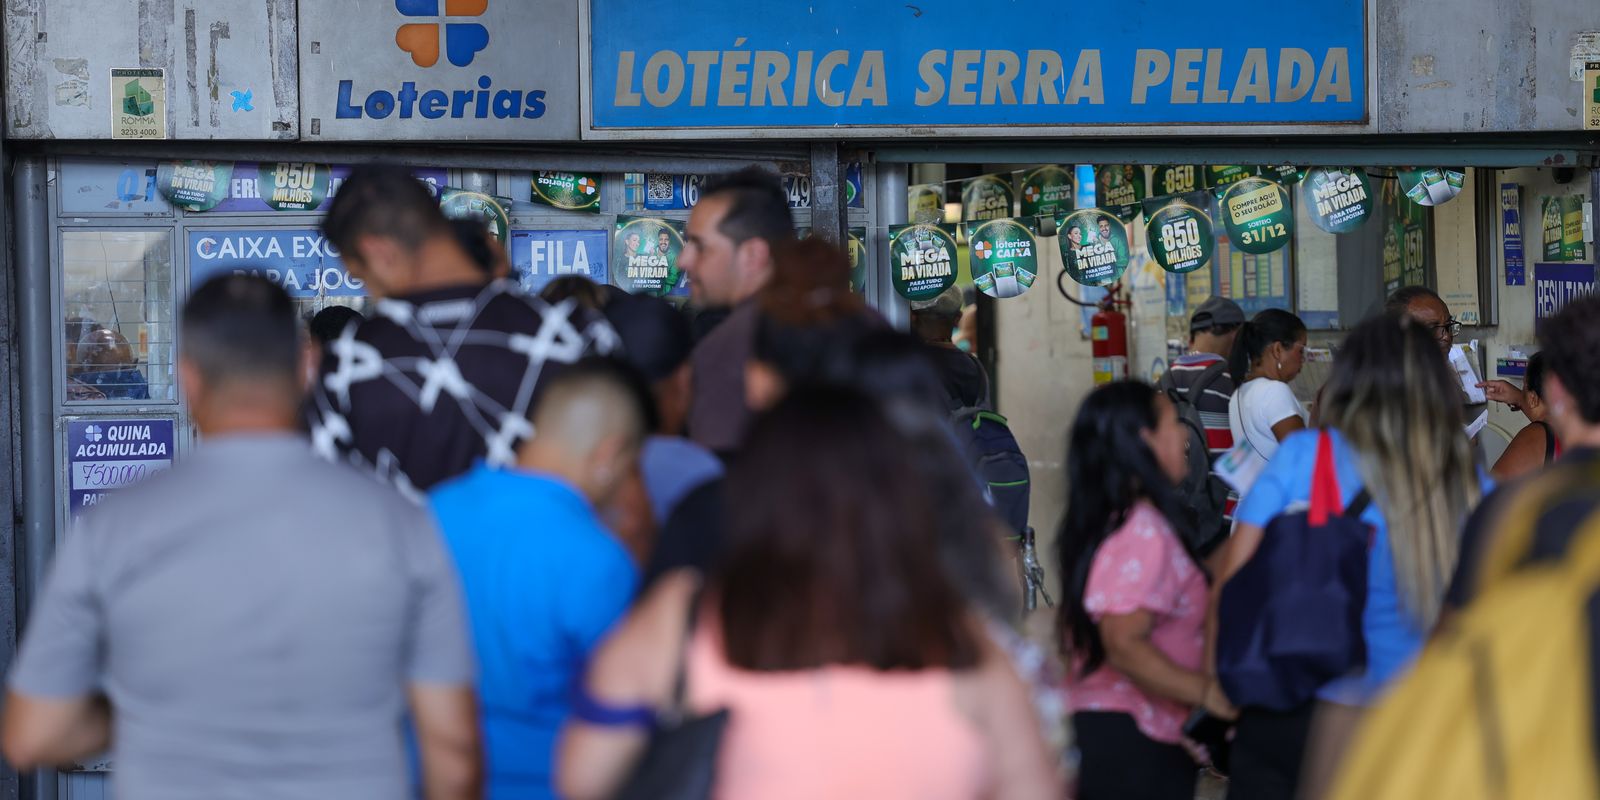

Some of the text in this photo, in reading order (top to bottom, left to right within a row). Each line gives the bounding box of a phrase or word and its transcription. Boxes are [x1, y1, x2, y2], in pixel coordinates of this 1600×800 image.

[613, 37, 1352, 108] LOTÉRICA SERRA PELADA
[335, 75, 547, 120] Loterias
[121, 116, 156, 126] ROMMA
[120, 128, 158, 136] 3233 4000
[174, 165, 215, 181] MEGA
[275, 162, 316, 190] 850
[1165, 165, 1195, 194] 850
[171, 176, 214, 193] DA VIRADA
[1312, 172, 1363, 202] MEGA
[272, 188, 313, 203] MILHÕES
[1231, 191, 1276, 211] COMPRE AQUI
[1316, 186, 1367, 217] DA VIRADA
[1241, 208, 1253, 216] SEU
[1329, 203, 1362, 221] PARA TUDO
[1247, 218, 1272, 229] SORTEIO
[1161, 217, 1200, 252] 850
[1241, 223, 1287, 245] 31/12
[196, 236, 285, 260] CAIXA
[995, 238, 1031, 249] loterias
[996, 247, 1032, 258] CAIXA
[1075, 241, 1115, 260] MEGA
[530, 239, 591, 275] FILA
[628, 255, 669, 267] MEGA
[900, 246, 951, 266] MEGA
[1077, 252, 1117, 270] DA VIRADA
[1165, 244, 1203, 265] MILHÕES
[627, 266, 668, 279] DA VIRADA
[901, 261, 952, 281] DA VIRADA
[909, 279, 926, 287] PARA
[1537, 279, 1595, 319] RESULTA
[107, 425, 152, 442] QUINA
[75, 442, 167, 458] ACUMULADA
